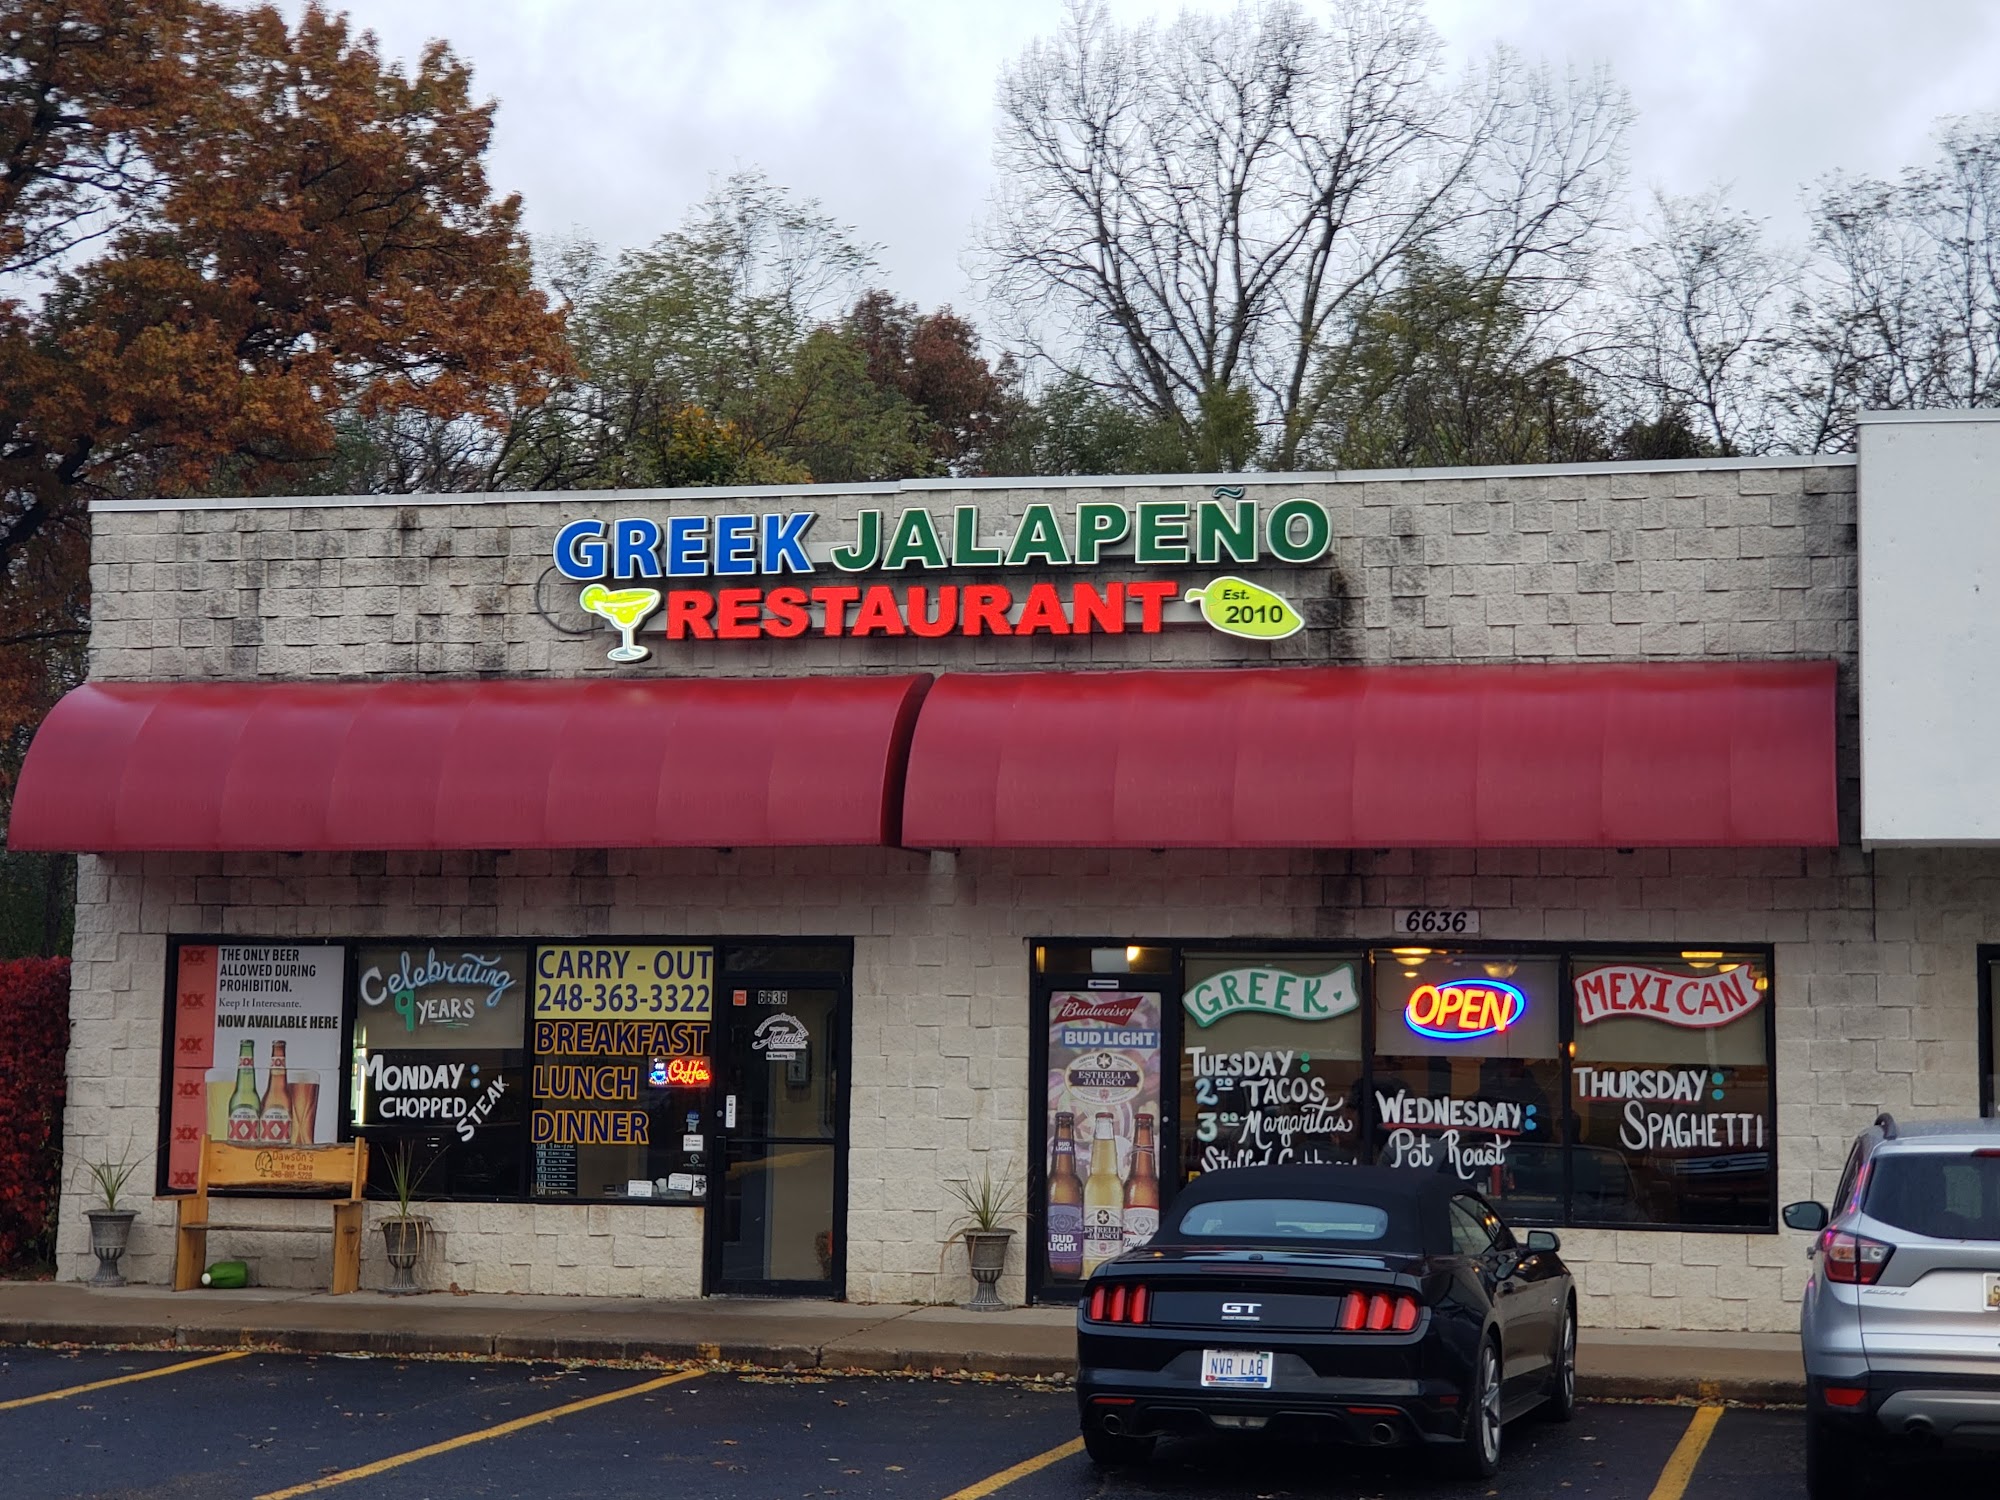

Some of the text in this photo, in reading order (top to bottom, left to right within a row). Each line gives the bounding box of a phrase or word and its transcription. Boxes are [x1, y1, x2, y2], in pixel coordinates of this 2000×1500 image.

[553, 486, 1332, 580] GREEK JALAPEÑO
[1222, 589, 1250, 600] Est.
[666, 580, 1181, 641] RESTAURANT
[1225, 605, 1283, 624] 2010
[1405, 911, 1468, 933] 6636
[221, 948, 299, 962] THE ONLY BEER
[220, 964, 316, 977] ALLOWED DURING
[360, 947, 517, 1009] Celebrating
[219, 980, 292, 993] PROHIBITION.
[758, 991, 787, 1004] 6636
[1194, 972, 1329, 1016] GREEK
[1581, 973, 1748, 1016] MEXICAN
[219, 998, 302, 1010] Keep It Interesante.
[537, 984, 711, 1013] 248-363-3322
[1061, 1002, 1134, 1017] Budweiser
[1409, 984, 1513, 1032] OPEN
[218, 1014, 339, 1029] NOW AVAILABLE HERE
[395, 989, 475, 1032] 9 YEARS
[535, 1021, 711, 1056] BREAKFAST
[1064, 1031, 1154, 1046] BUD LIGHT
[533, 1065, 639, 1101] LUNCH
[667, 1057, 711, 1086] Coffee
[1078, 1071, 1131, 1079] ESTRELLA
[1083, 1078, 1126, 1086] JALISCO
[1240, 1077, 1326, 1107] TACOS
[379, 1096, 467, 1119] CHOPPED
[456, 1074, 510, 1142] STEAK
[531, 1110, 650, 1145] DINNER
[1238, 1096, 1353, 1150] Margaritas
[1619, 1100, 1763, 1151] SPAGHETTI
[1388, 1129, 1512, 1180] Pot Roast
[1047, 1243, 1077, 1252] LIGHT
[1051, 1234, 1074, 1243] BUD
[1222, 1303, 1262, 1313] GT
[1210, 1357, 1233, 1375] NVR
